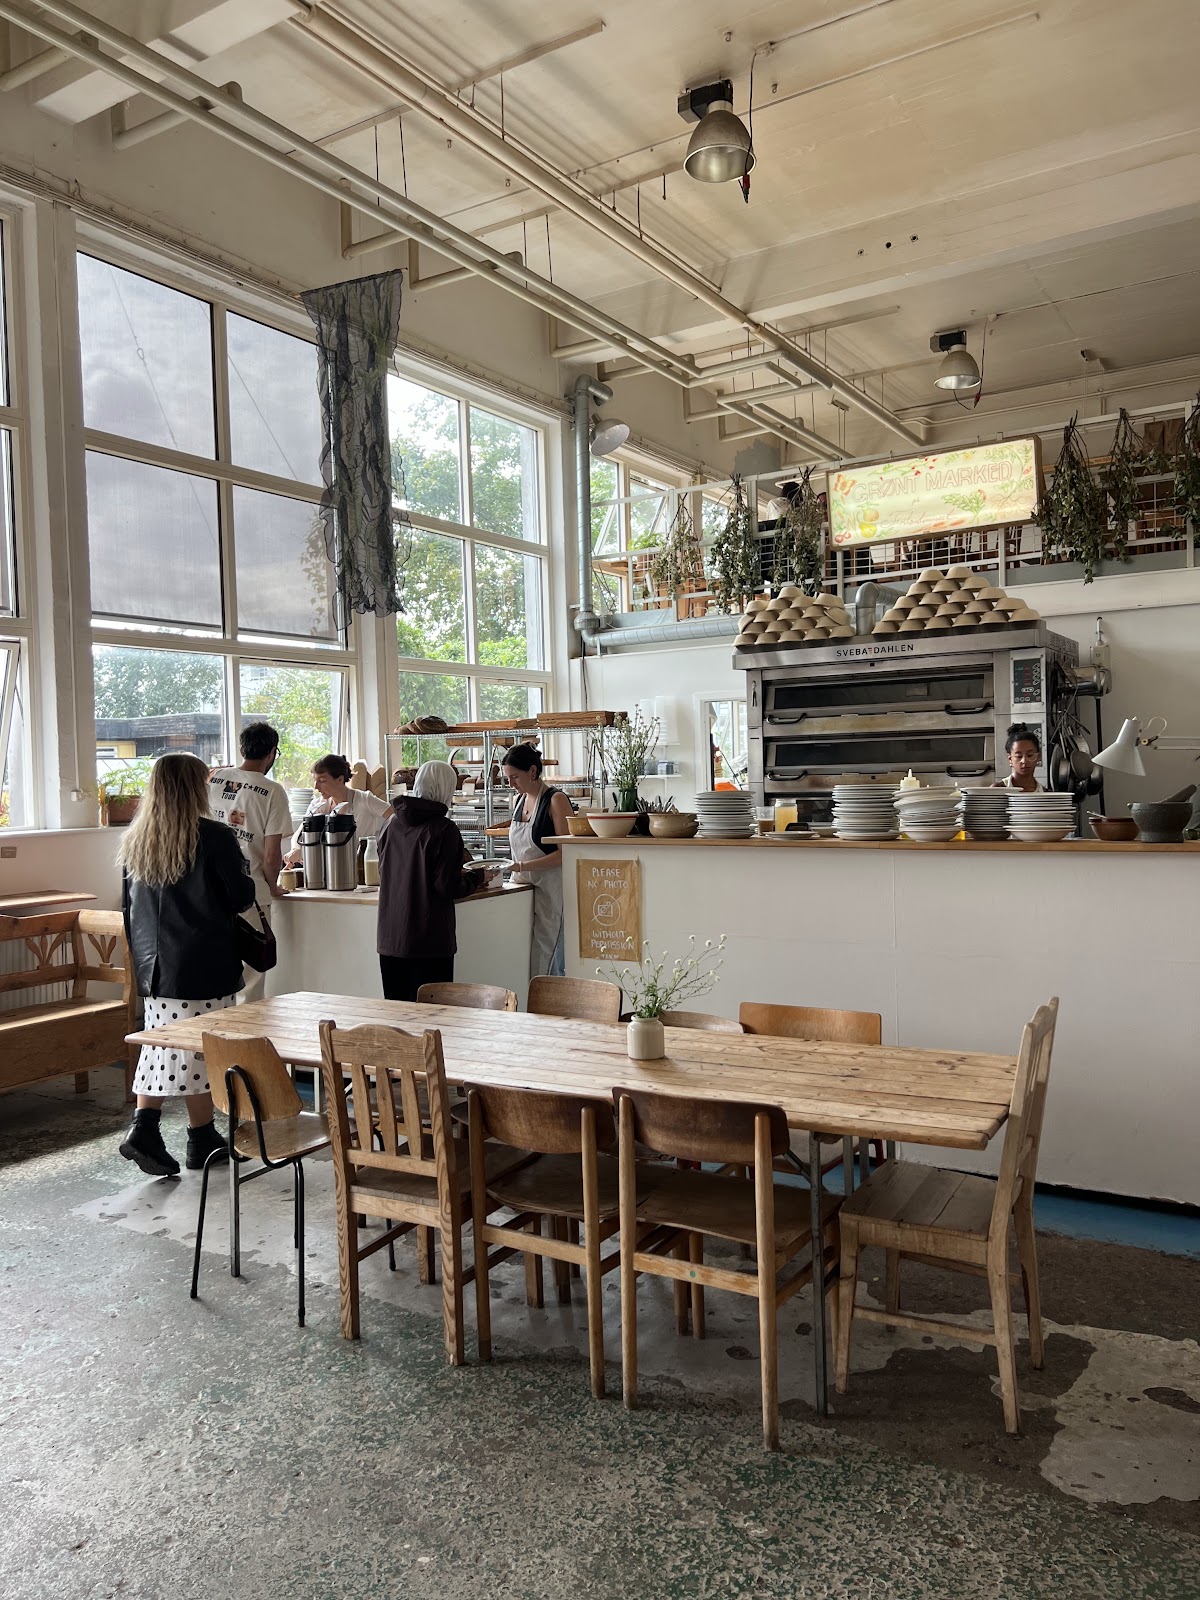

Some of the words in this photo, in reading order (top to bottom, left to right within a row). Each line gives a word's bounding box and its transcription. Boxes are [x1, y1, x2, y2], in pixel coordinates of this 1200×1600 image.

[852, 475, 921, 502] GRØNT
[926, 460, 1013, 491] MARKED
[592, 867, 620, 876] PLEASE
[587, 880, 599, 888] NO
[604, 880, 629, 889] PHOTO
